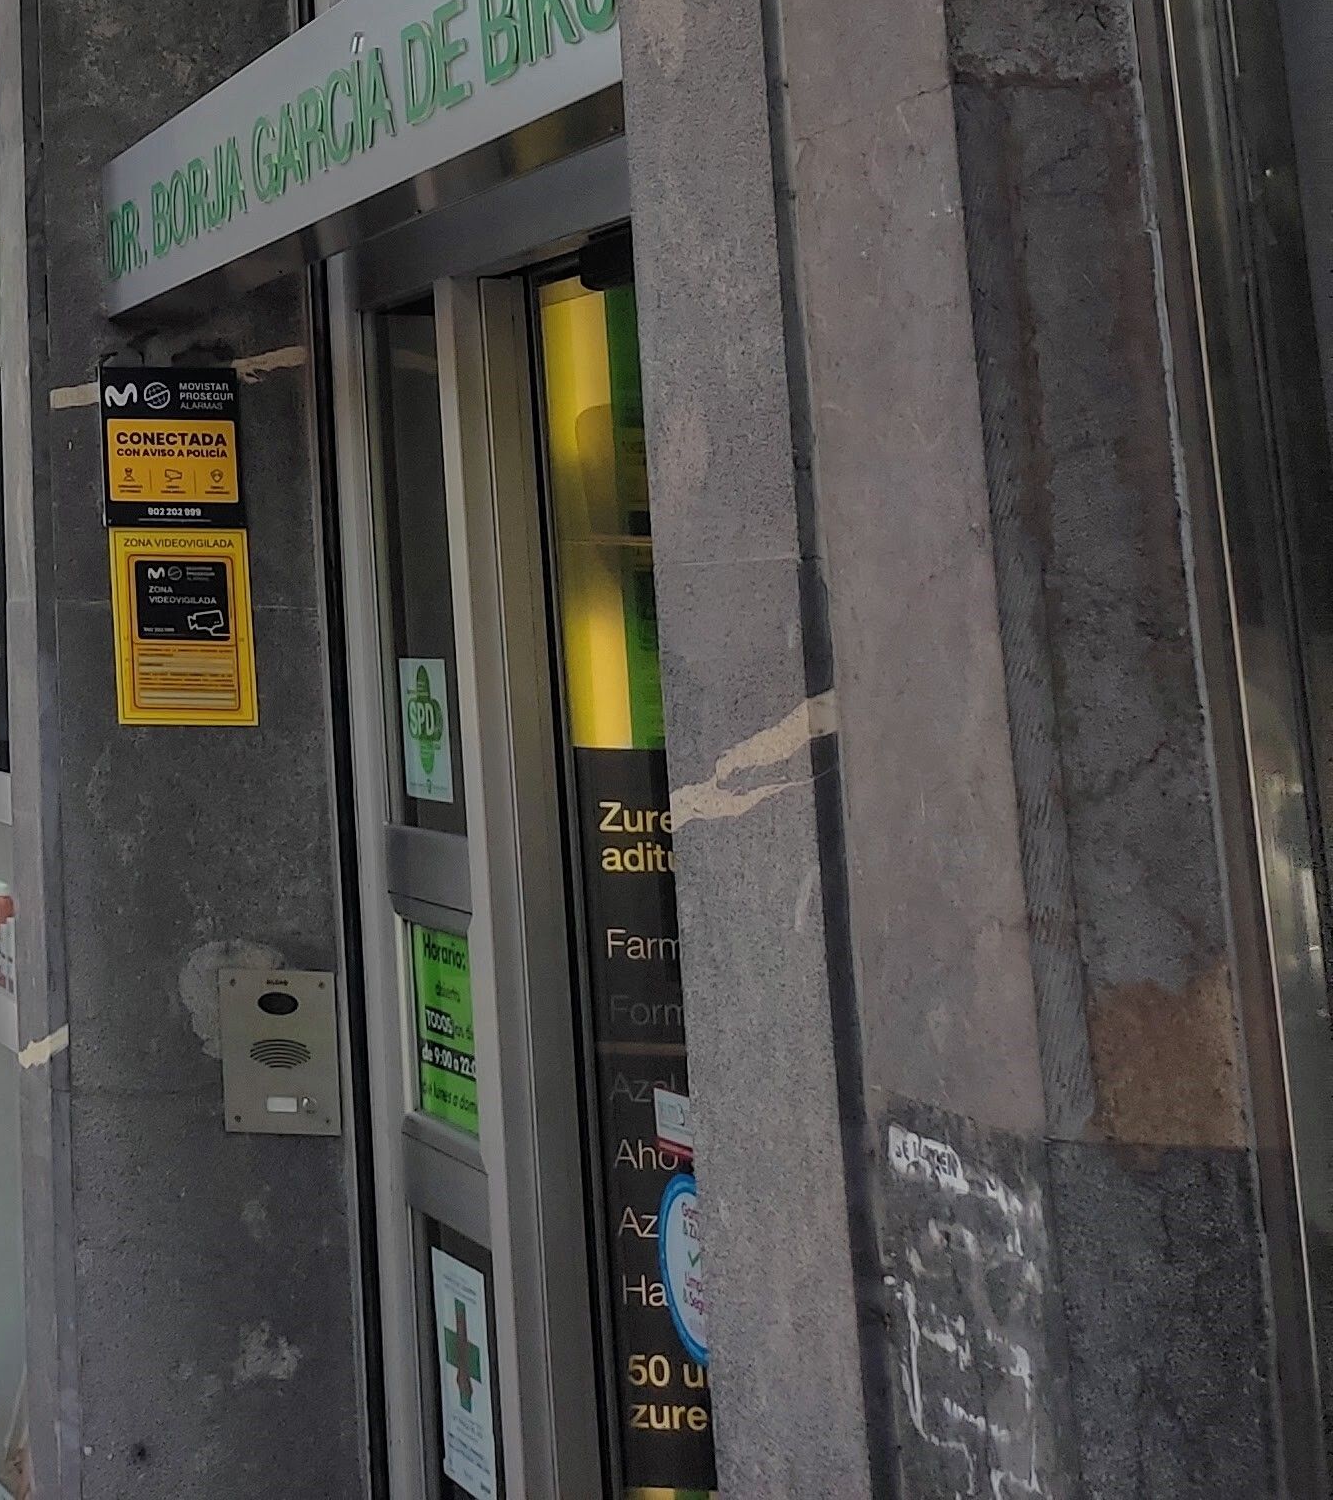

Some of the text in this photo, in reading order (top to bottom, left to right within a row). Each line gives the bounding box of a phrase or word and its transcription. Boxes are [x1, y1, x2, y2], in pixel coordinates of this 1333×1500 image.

[107, 203, 148, 280] DR.
[151, 136, 248, 258] BORJA
[252, 32, 397, 203] GARCÍA
[179, 382, 229, 391] MOVISTAR
[179, 392, 234, 401] PROSEGUR
[180, 402, 223, 410] ALARMAS
[116, 432, 227, 447] CONECTADA
[116, 448, 228, 458] CON AVISO A POLICÍA
[166, 507, 183, 516] 202
[124, 538, 234, 549] ZONA VIDEOVIGILADA
[148, 585, 174, 594] ZONA
[148, 595, 217, 605] VIDEOVIGILADA
[409, 701, 435, 736] SPD
[599, 801, 672, 833] Zure
[422, 931, 466, 972] Horario:
[606, 928, 681, 960] Farm
[426, 1008, 454, 1036] TODOS
[421, 1041, 433, 1063] de
[618, 1206, 660, 1240] Az
[623, 1274, 669, 1308] Ha
[628, 1354, 670, 1388] 50
[631, 1405, 709, 1432] zure
